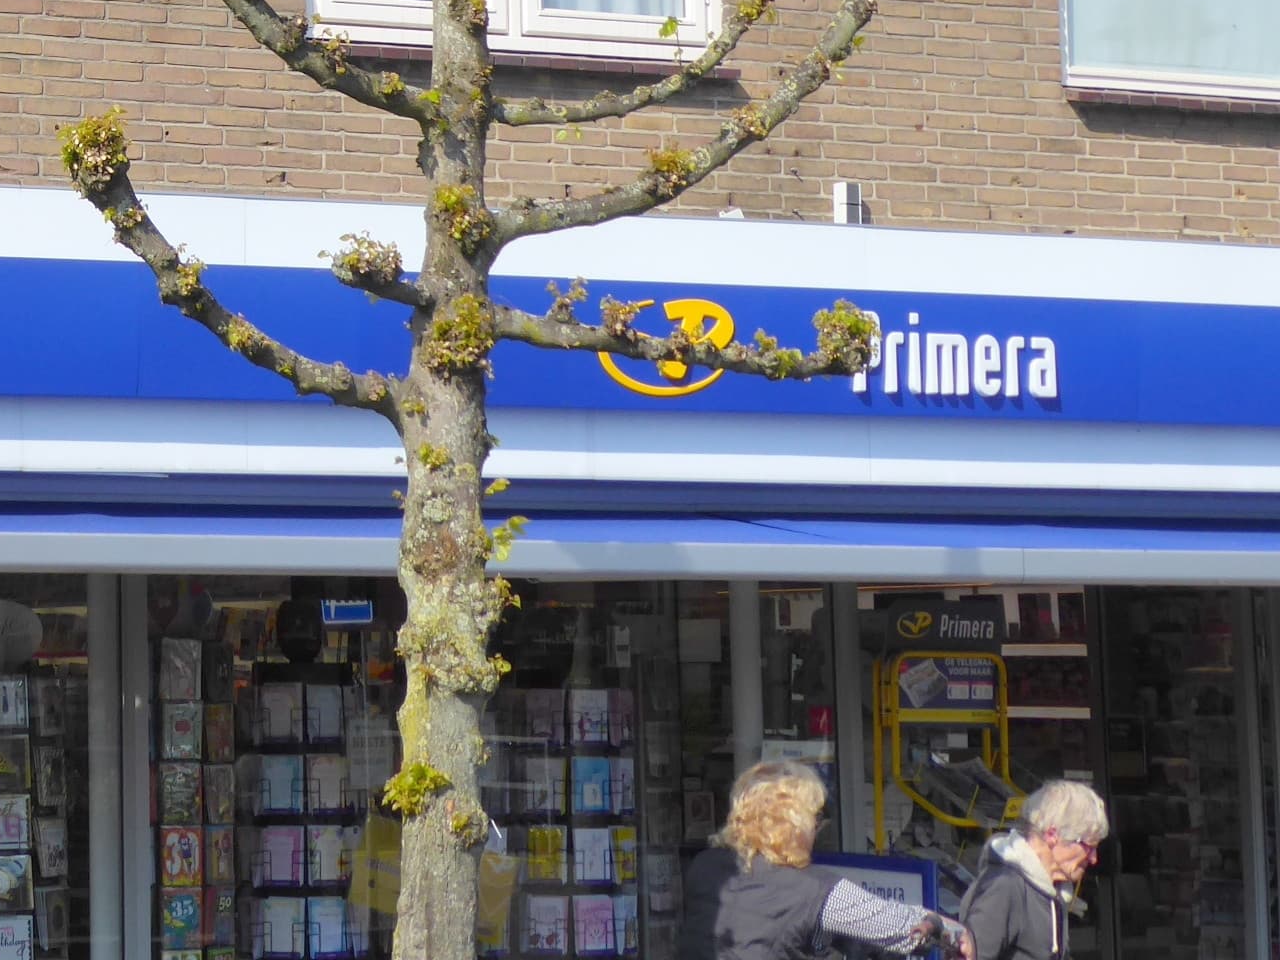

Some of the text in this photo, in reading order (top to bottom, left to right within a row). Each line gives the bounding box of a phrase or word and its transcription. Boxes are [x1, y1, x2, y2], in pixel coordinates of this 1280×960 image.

[940, 613, 995, 639] Primera
[171, 899, 194, 919] 35
[218, 897, 232, 911] 50
